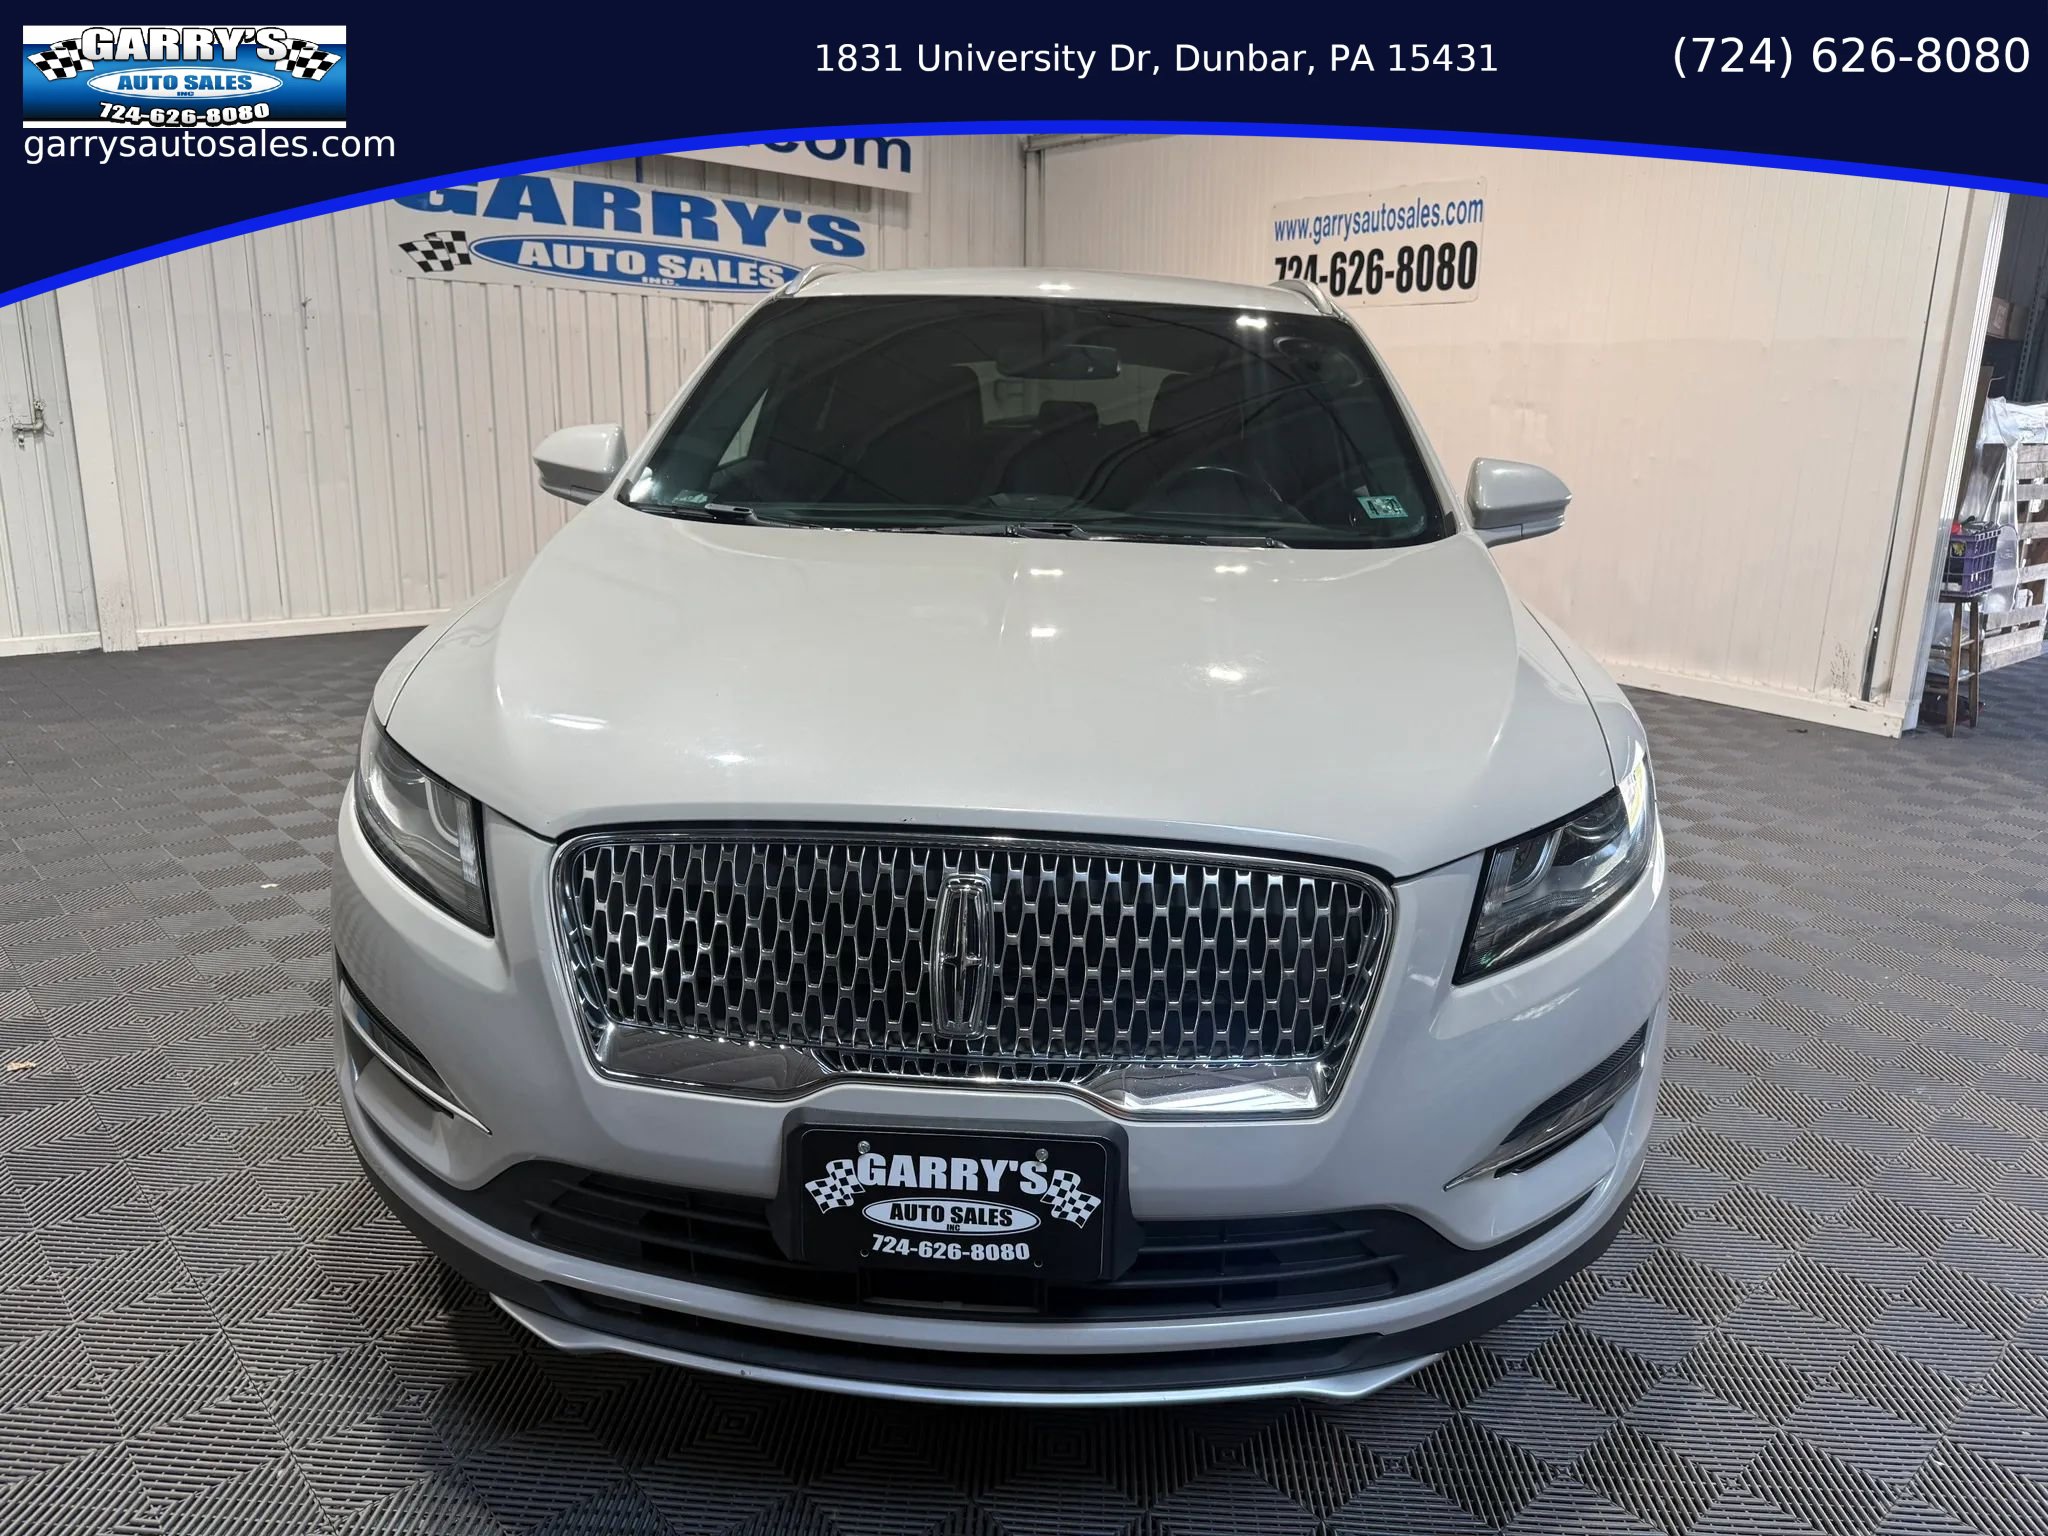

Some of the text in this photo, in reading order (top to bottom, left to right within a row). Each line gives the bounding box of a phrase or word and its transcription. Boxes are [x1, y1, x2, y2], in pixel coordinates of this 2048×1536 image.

[1274, 197, 1484, 245] www.garrysautosales.com
[517, 240, 785, 288] AUTO SALES
[857, 1152, 1048, 1195] GARRY'S
[889, 1203, 1013, 1227] AUTO SALES
[946, 1223, 961, 1232] INC
[872, 1233, 1030, 1261] 724-626-8080
